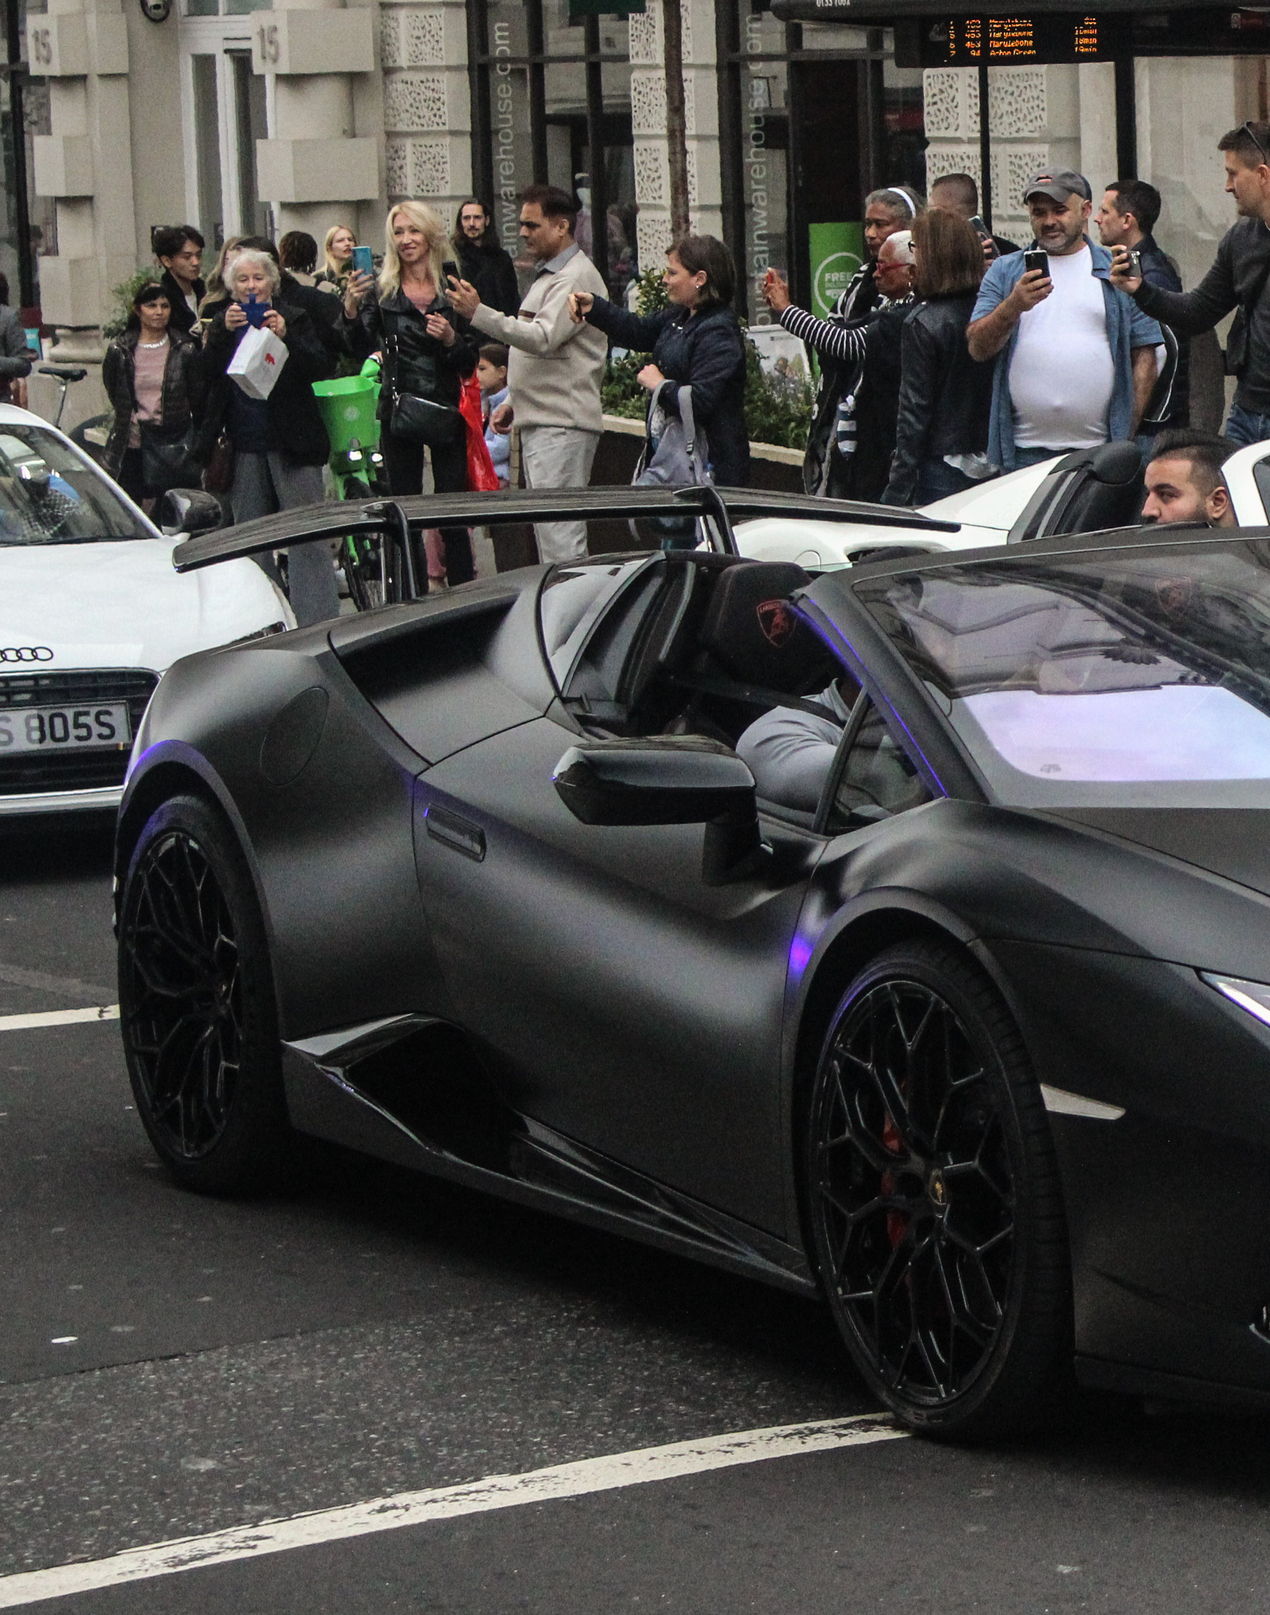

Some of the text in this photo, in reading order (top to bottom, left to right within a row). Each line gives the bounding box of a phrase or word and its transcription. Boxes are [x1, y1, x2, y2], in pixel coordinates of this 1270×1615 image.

[33, 29, 51, 65] 15
[257, 25, 279, 64] 15
[825, 271, 853, 282] FREE
[25, 709, 117, 744] 805S
